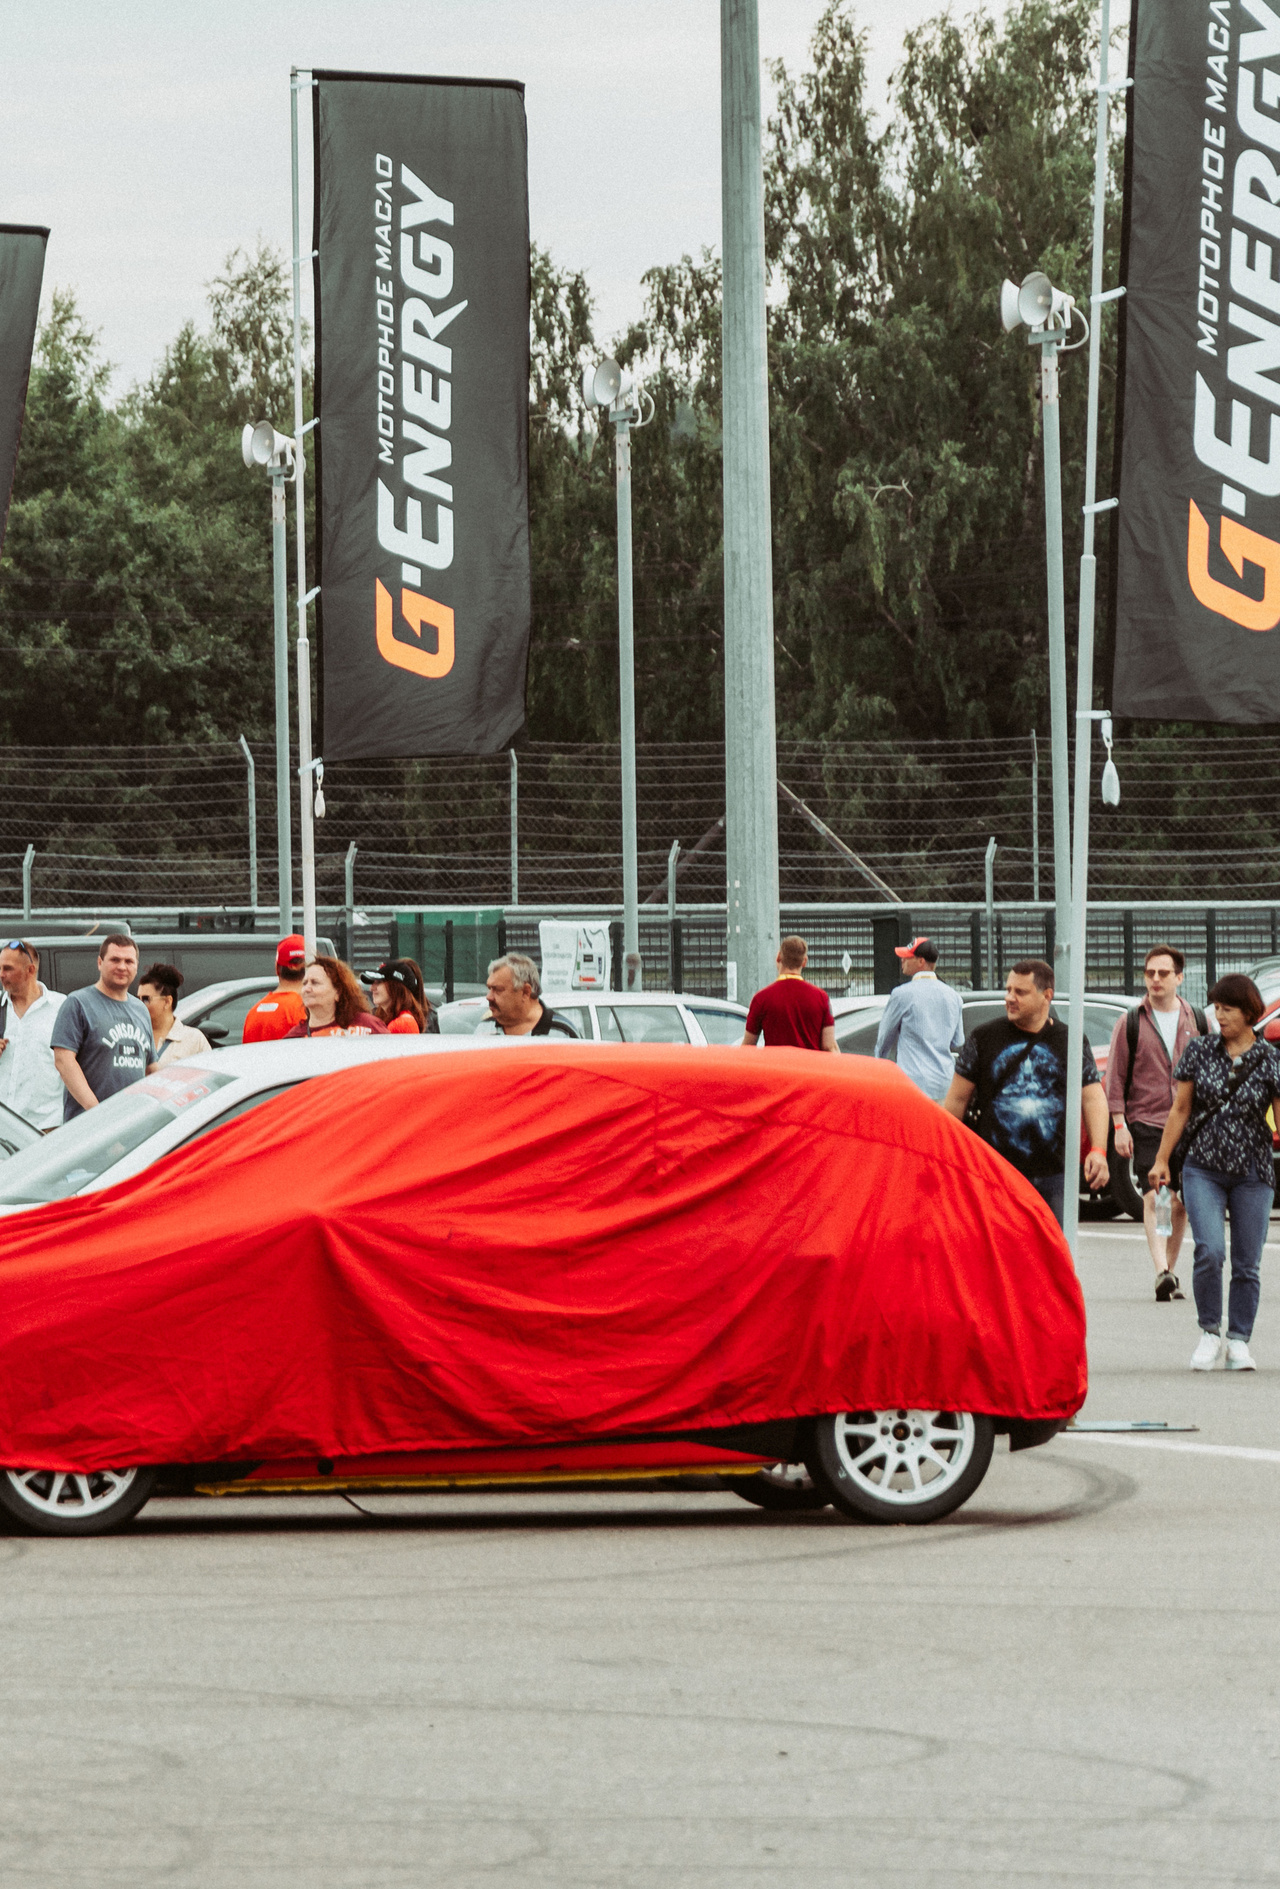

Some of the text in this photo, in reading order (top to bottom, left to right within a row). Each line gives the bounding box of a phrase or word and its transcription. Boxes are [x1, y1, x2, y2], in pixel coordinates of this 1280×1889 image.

[375, 152, 395, 466] МОТОРНОЕ МАСЛО
[1196, 0, 1232, 357] МОТОРНОЕ МАСЛ
[375, 163, 469, 680] G-ENERGY
[113, 1055, 144, 1069] LONDON
